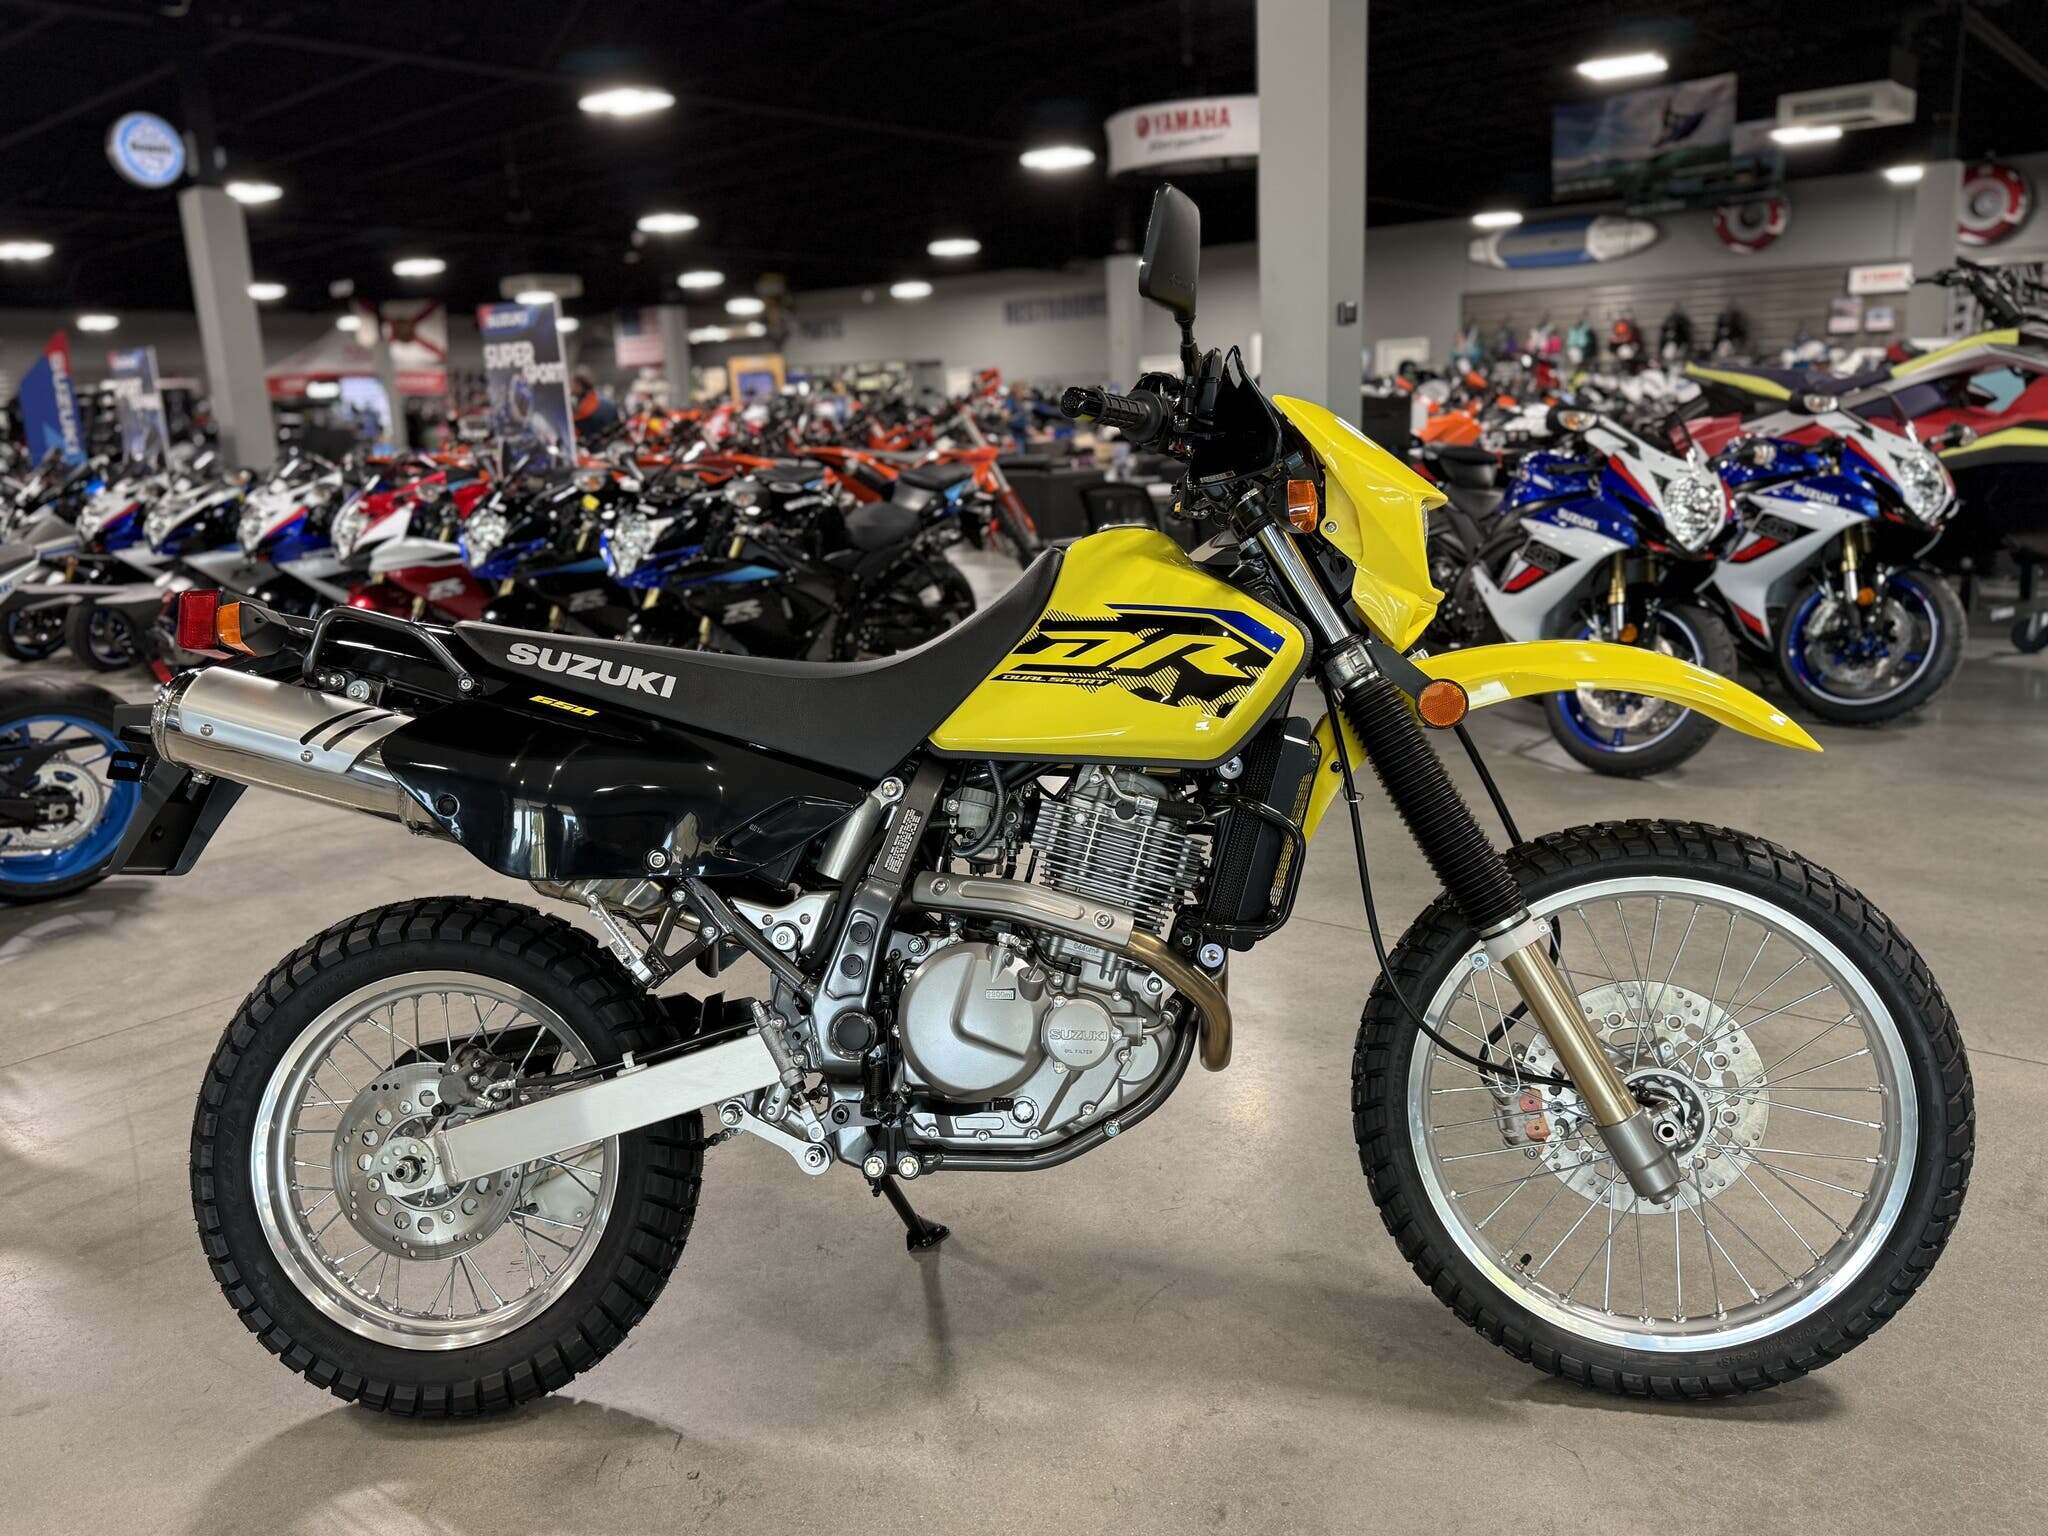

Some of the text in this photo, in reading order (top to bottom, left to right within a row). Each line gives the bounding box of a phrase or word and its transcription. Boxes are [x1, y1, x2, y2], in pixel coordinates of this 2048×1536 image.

[1154, 107, 1233, 134] YAMAHA
[484, 341, 535, 369] SUPER
[522, 362, 566, 385] SPORT
[49, 351, 80, 454] SUZUKI
[1793, 482, 1840, 506] SUZUKI
[1557, 507, 1600, 532] SUZUKI
[506, 643, 677, 699] SUZUKI
[1002, 674, 1108, 686] DUAL SPORT
[529, 695, 600, 717] 650
[1049, 1029, 1108, 1042] SUZUKI
